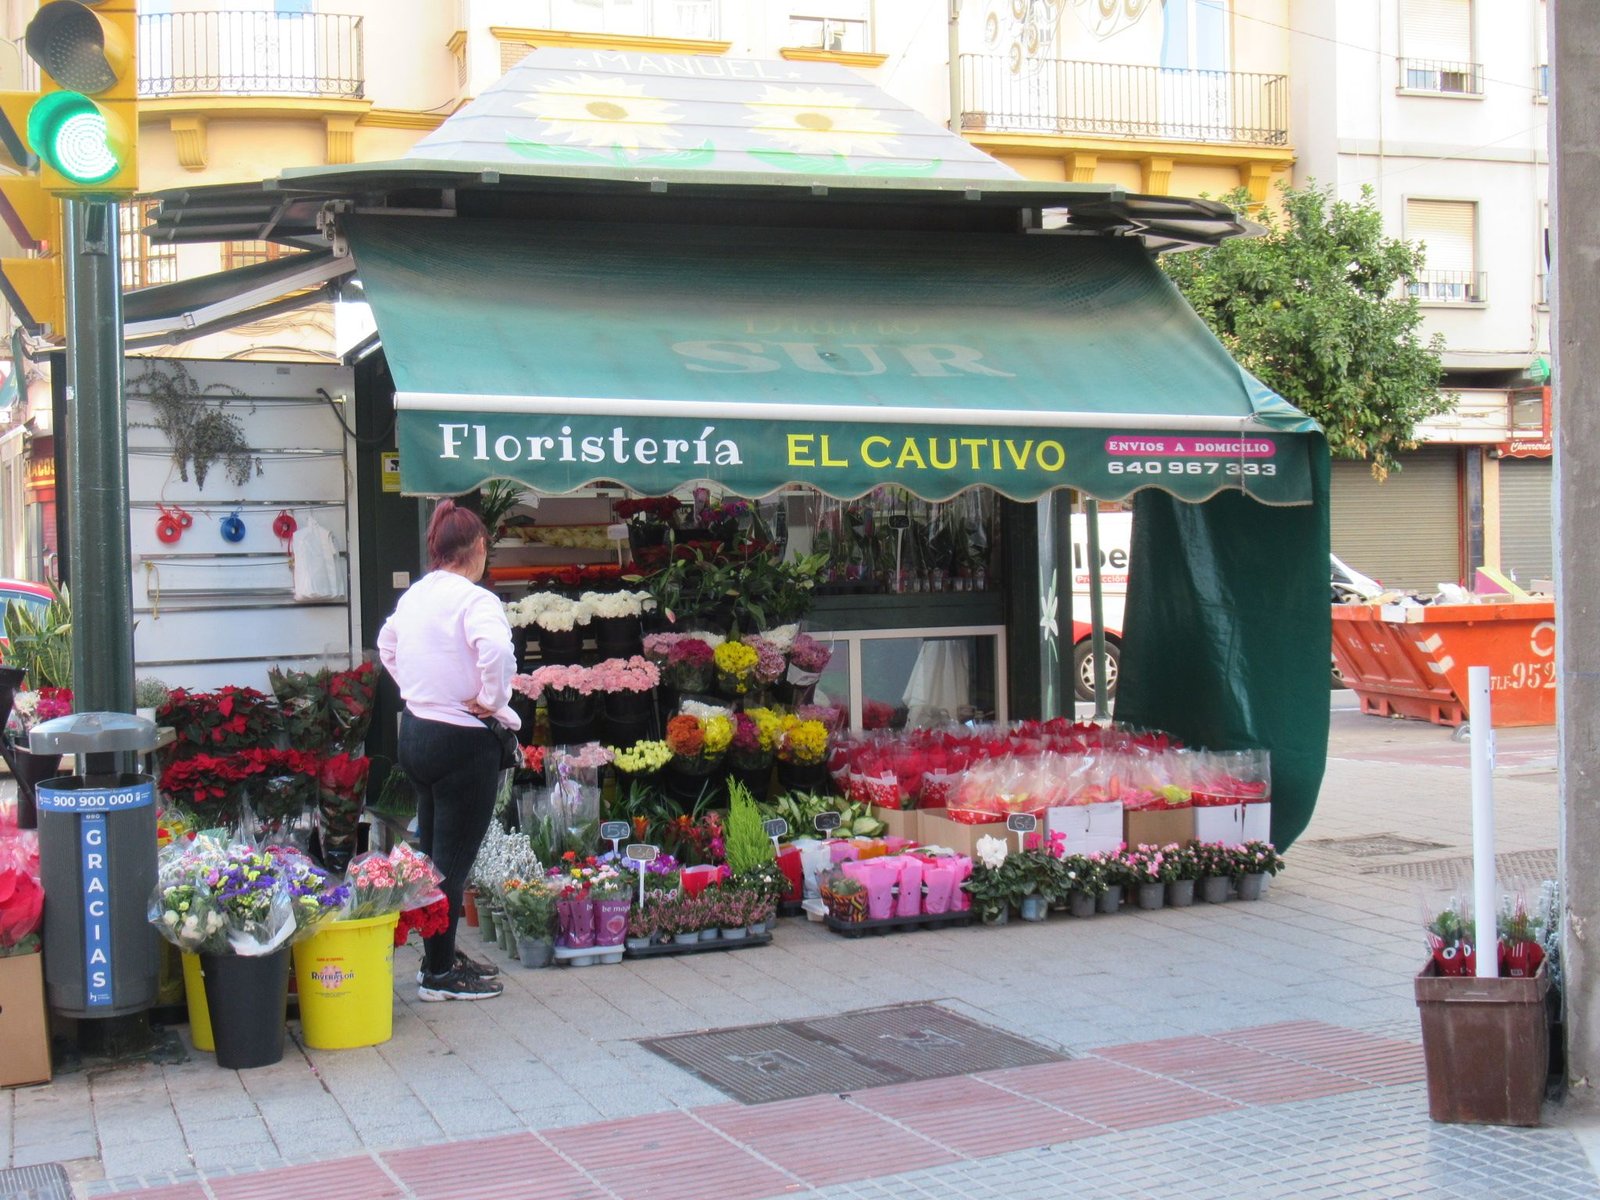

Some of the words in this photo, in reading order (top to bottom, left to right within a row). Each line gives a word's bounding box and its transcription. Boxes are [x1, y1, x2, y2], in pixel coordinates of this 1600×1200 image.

[592, 51, 781, 79] MANUEL
[671, 339, 1016, 377] SUR
[438, 423, 743, 466] Floristería
[786, 433, 848, 468] EL
[860, 435, 1066, 472] CAUTIVO
[1109, 441, 1164, 452] ENVIOS
[1175, 441, 1185, 452] A
[1195, 442, 1269, 453] DOMICILIO
[1108, 461, 1162, 474] 640
[1168, 462, 1217, 474] 967
[1225, 463, 1277, 476] 333
[53, 795, 76, 807] 900
[79, 795, 106, 807] 900
[109, 792, 134, 806] 000
[86, 829, 107, 988] GRACIAS
